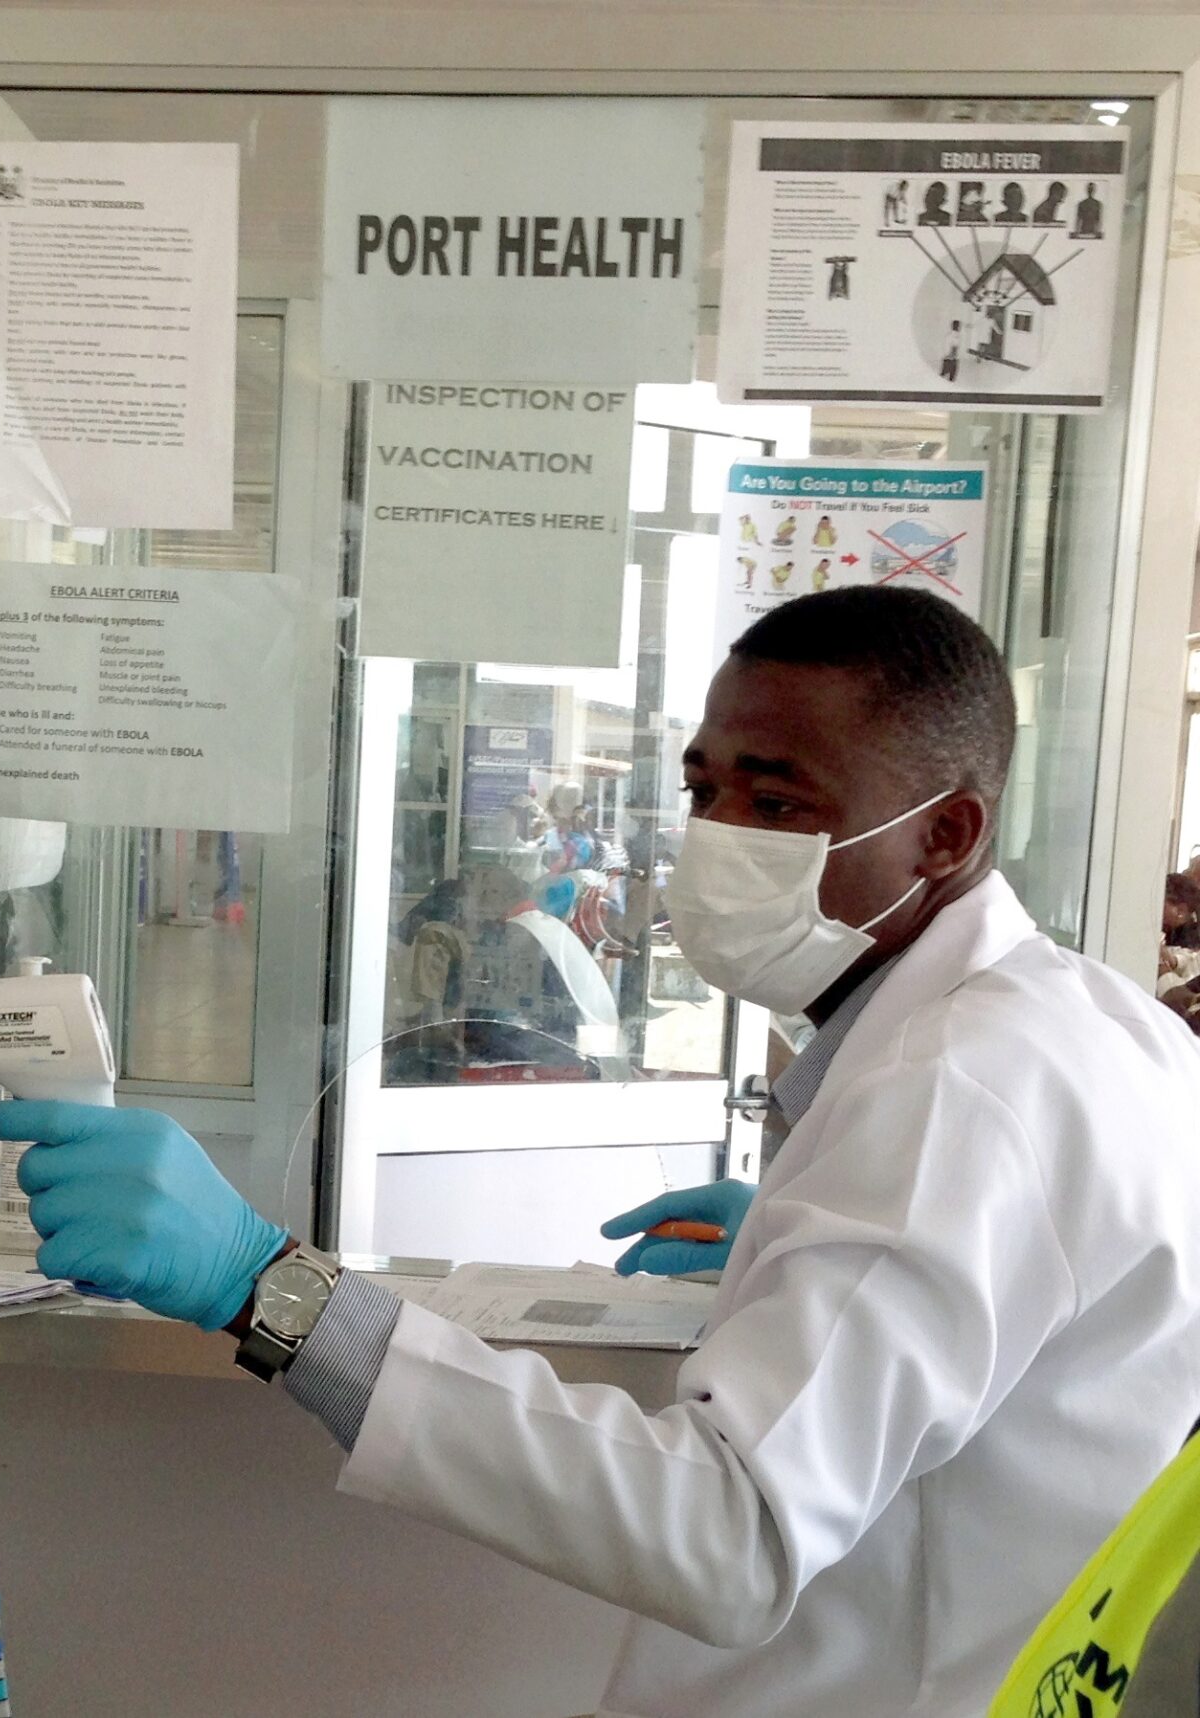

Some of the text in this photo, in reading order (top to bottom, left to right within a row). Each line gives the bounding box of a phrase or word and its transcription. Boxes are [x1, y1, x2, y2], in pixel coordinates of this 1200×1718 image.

[940, 152, 1041, 170] EBOLA FEVER
[357, 214, 683, 278] PORT HEALTH
[386, 383, 627, 412] INSPECTION OF
[377, 446, 593, 474] VACCINATION
[743, 474, 967, 496] Are You Going to the Airport?
[770, 499, 787, 509] Do
[789, 500, 812, 510] NOT
[814, 501, 848, 511] Travel
[861, 503, 879, 512] You
[374, 506, 605, 531] CERTIFICATES HERE
[50, 585, 180, 601] EBOLA ALERT CRITERIA
[0, 611, 20, 621] plus
[22, 612, 29, 620] 3
[31, 612, 42, 621] of
[43, 612, 60, 622] the
[62, 613, 109, 626] following
[111, 616, 165, 628] symptoms:
[8, 708, 29, 719] who
[31, 709, 39, 719] is
[41, 710, 50, 719] ill
[52, 711, 75, 720] and:
[0, 724, 150, 740] Cared for someone with EBOLA
[0, 740, 40, 750] Attended
[51, 741, 86, 752] funeral
[88, 743, 99, 753] of
[100, 745, 144, 755] someone
[146, 745, 168, 756] with
[170, 747, 204, 758] EBOLA
[51, 770, 80, 781] death
